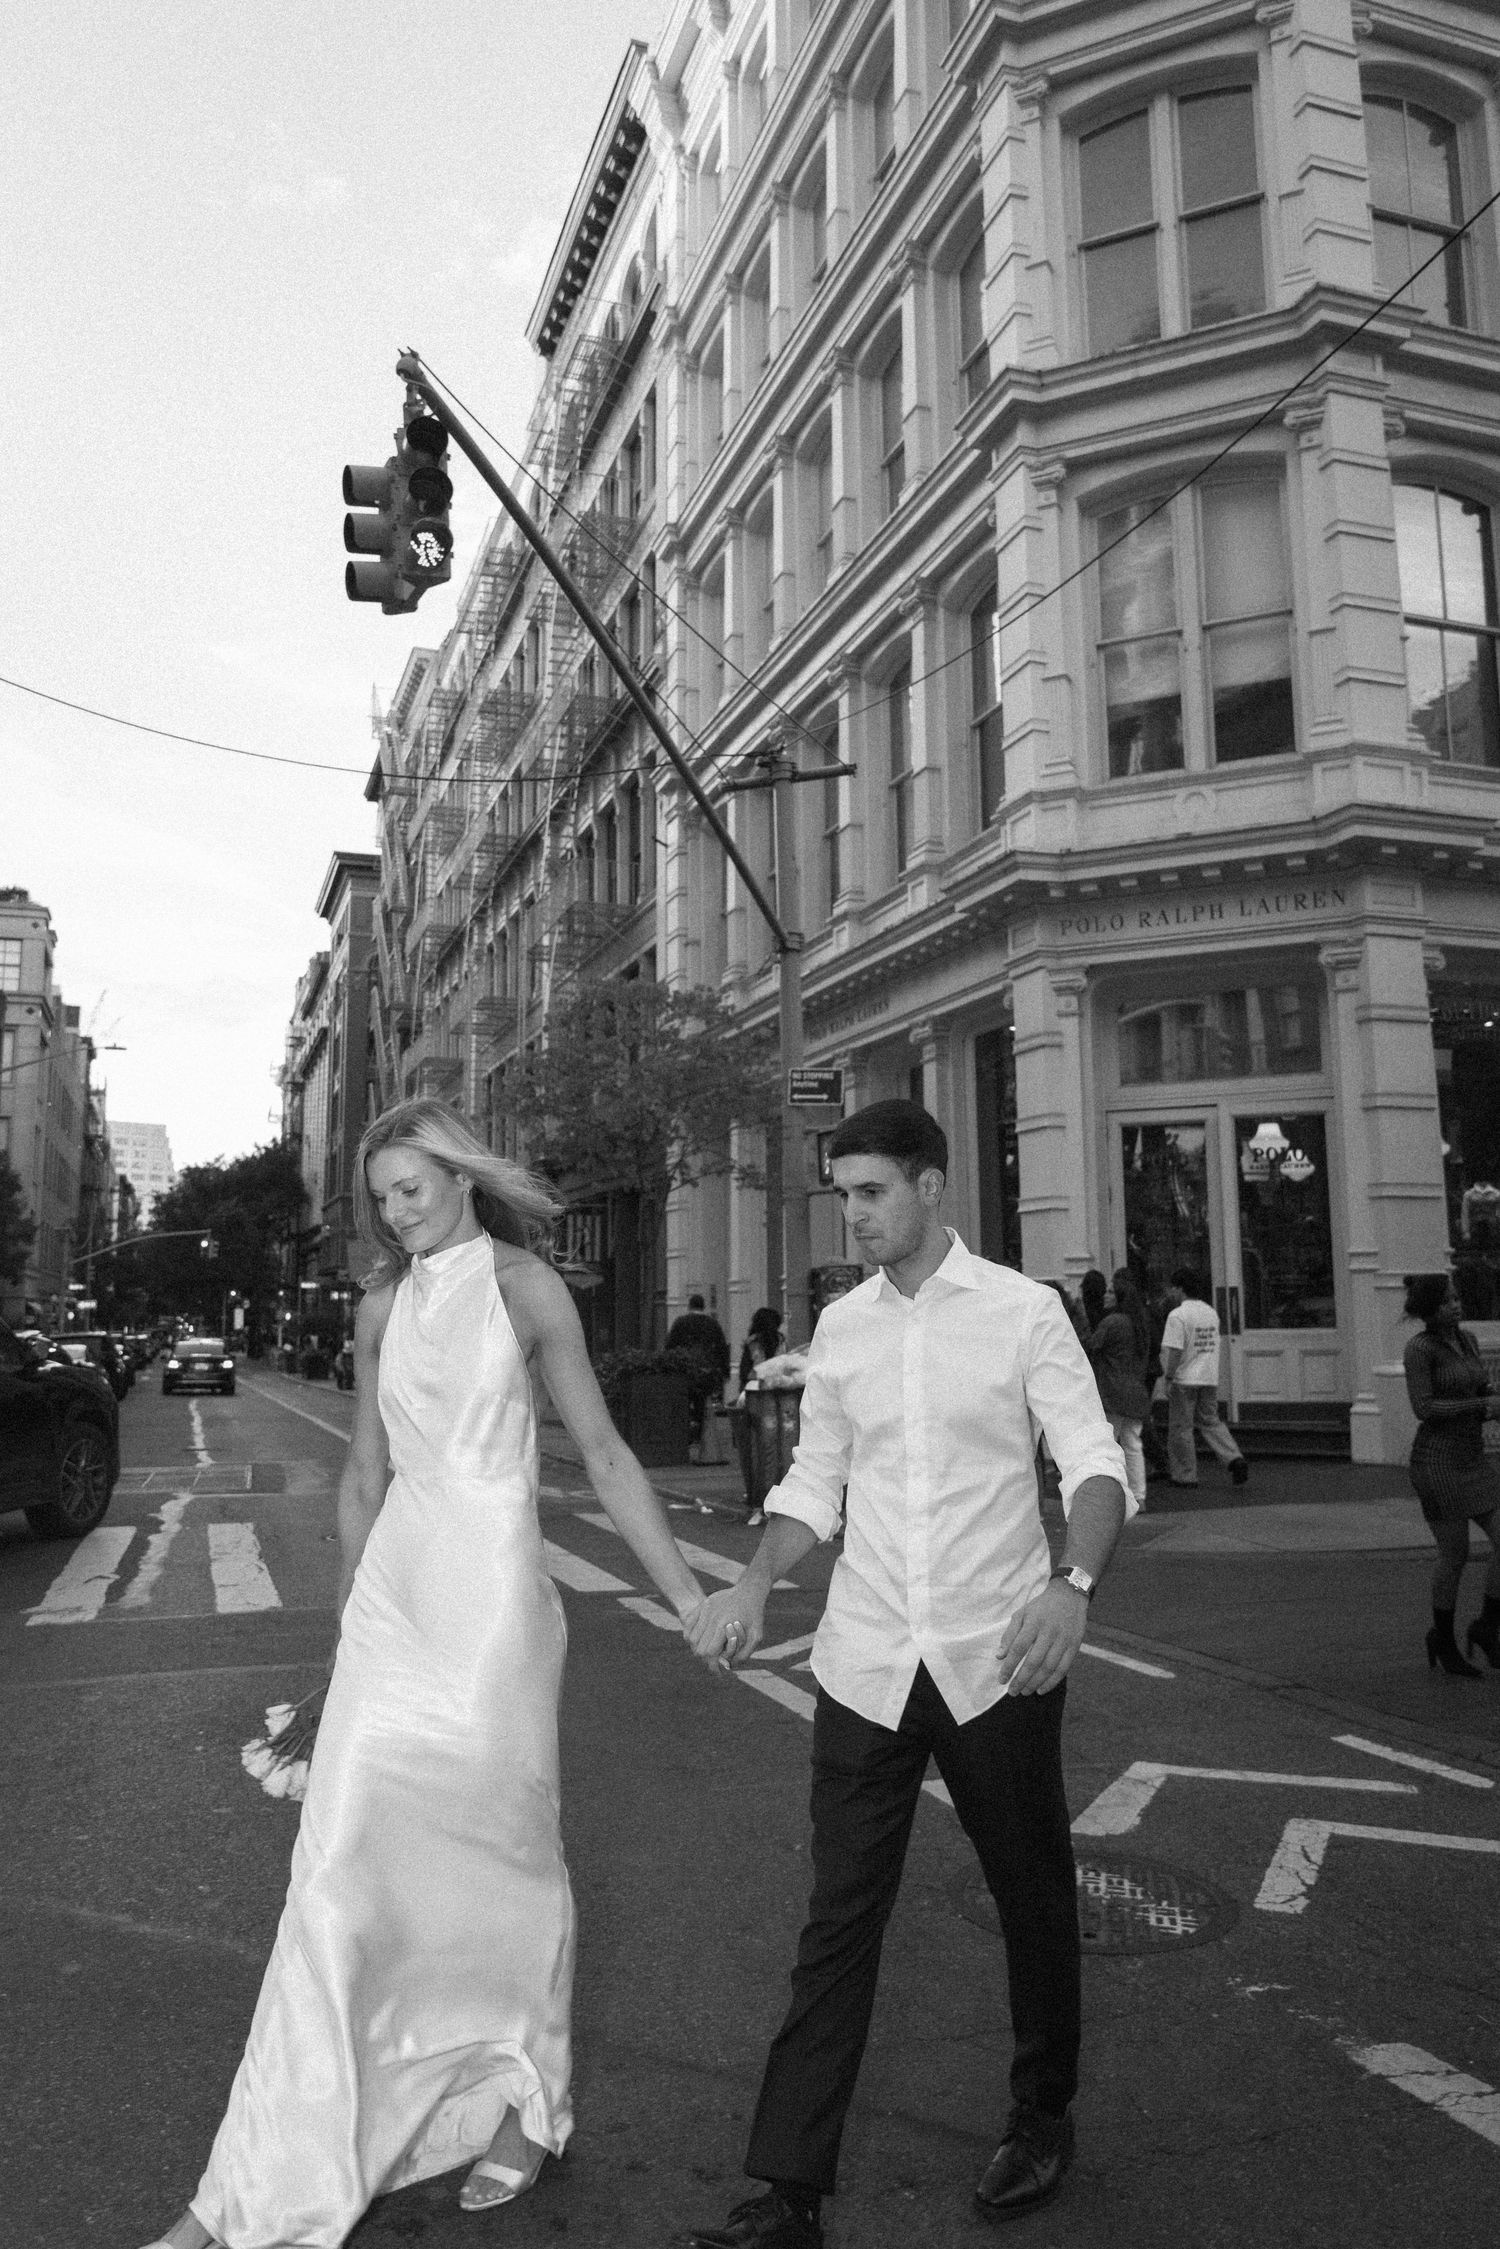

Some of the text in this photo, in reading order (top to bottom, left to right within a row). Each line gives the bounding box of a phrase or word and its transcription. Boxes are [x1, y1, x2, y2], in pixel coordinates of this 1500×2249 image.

[1060, 889, 1346, 936] POLO RALPH LAUREN
[1253, 1147, 1306, 1162] POLO
